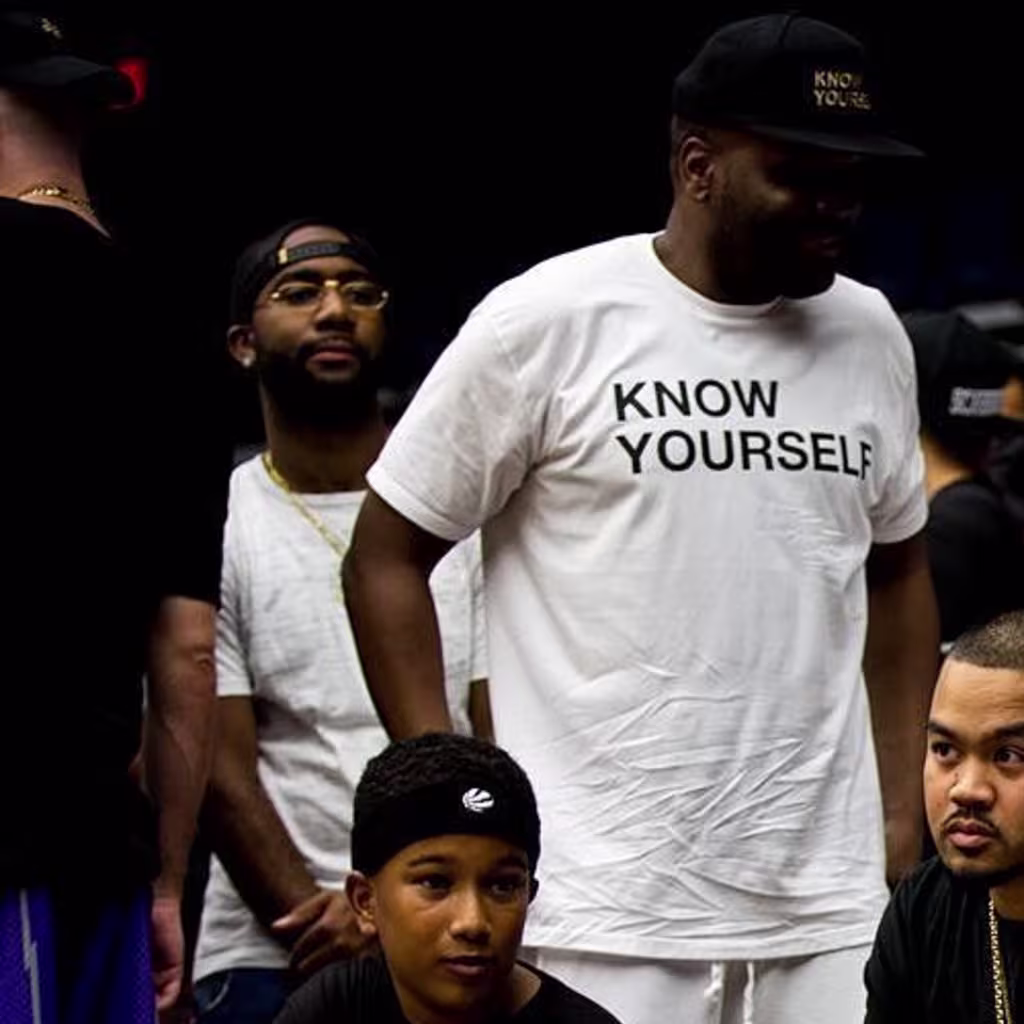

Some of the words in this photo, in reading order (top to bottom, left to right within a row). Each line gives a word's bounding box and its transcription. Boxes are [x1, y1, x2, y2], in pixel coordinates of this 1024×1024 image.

[814, 70, 862, 89] KNO
[613, 379, 778, 421] KNOW
[615, 430, 872, 480] YOURSELF
